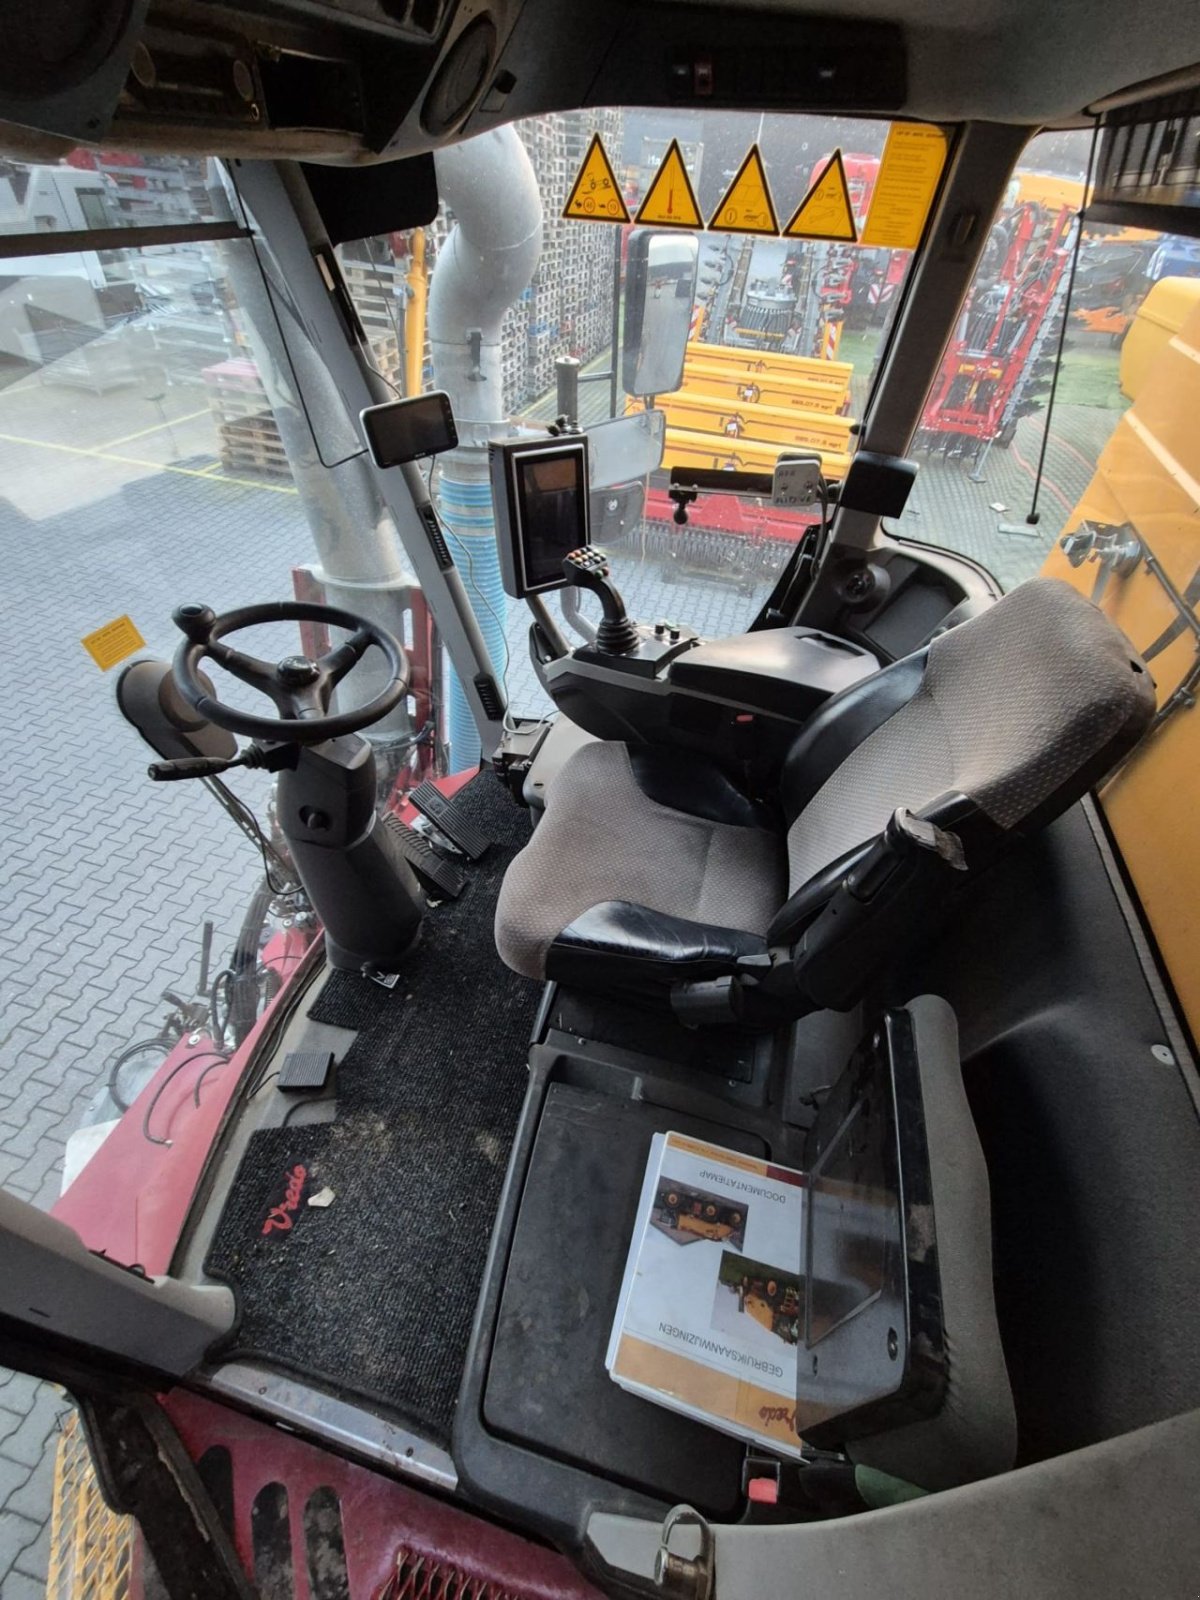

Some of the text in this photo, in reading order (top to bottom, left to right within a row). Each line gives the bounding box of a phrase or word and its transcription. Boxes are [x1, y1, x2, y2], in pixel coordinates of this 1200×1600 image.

[261, 1164, 307, 1235] Vredo
[699, 1170, 787, 1204] DOCUMENTATIEMAP
[658, 1321, 784, 1379] GEBRUIKSAANWIJZINGEN
